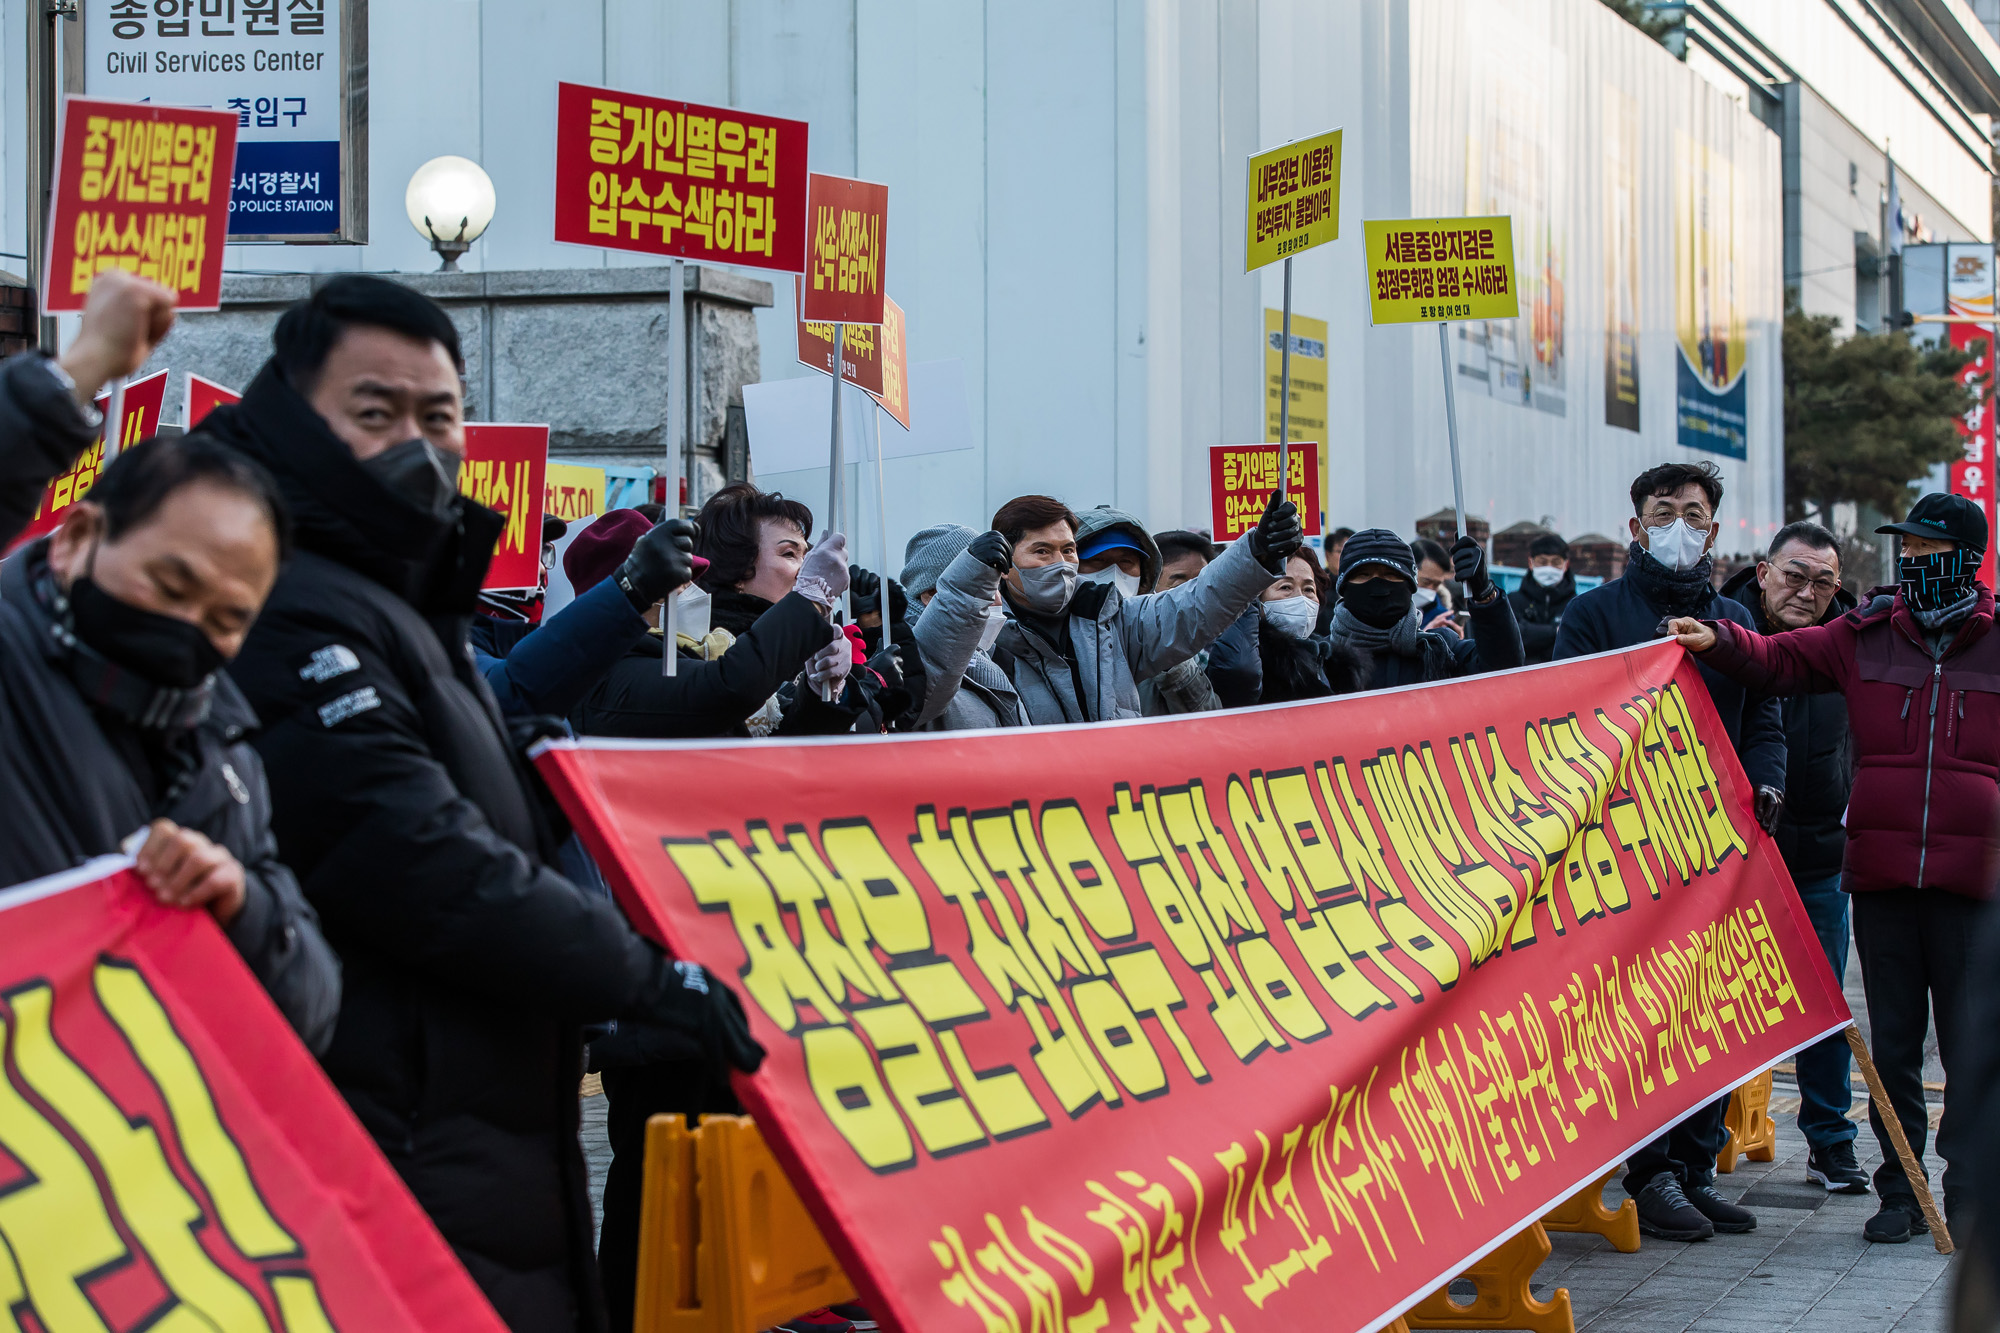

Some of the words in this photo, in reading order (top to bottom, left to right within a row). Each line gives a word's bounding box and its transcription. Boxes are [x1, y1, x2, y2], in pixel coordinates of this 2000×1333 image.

[107, 52, 147, 74] Civil
[155, 51, 246, 73] Services
[253, 49, 324, 72] Center
[227, 97, 307, 128] 출입구
[79, 115, 217, 205] 증거인멸우려
[588, 98, 777, 189] 증거인멸우려
[1257, 155, 1299, 203] 내부정보
[1301, 144, 1333, 188] 이용한
[240, 200, 282, 212] POLICE
[284, 200, 334, 212] STATION
[588, 171, 777, 257] 압수수색하라
[1385, 229, 1495, 263] 서울중앙지검은
[1376, 267, 1435, 300] 최정우회장
[1436, 266, 1461, 298] 엄정
[1462, 264, 1508, 297] 수사하라
[1225, 492, 1307, 533] 압수수라
[660, 817, 1051, 1175] 경찰은
[908, 797, 1213, 1122] 최정우
[1106, 778, 1333, 1065] 회장
[1594, 678, 1748, 902] 수사하라
